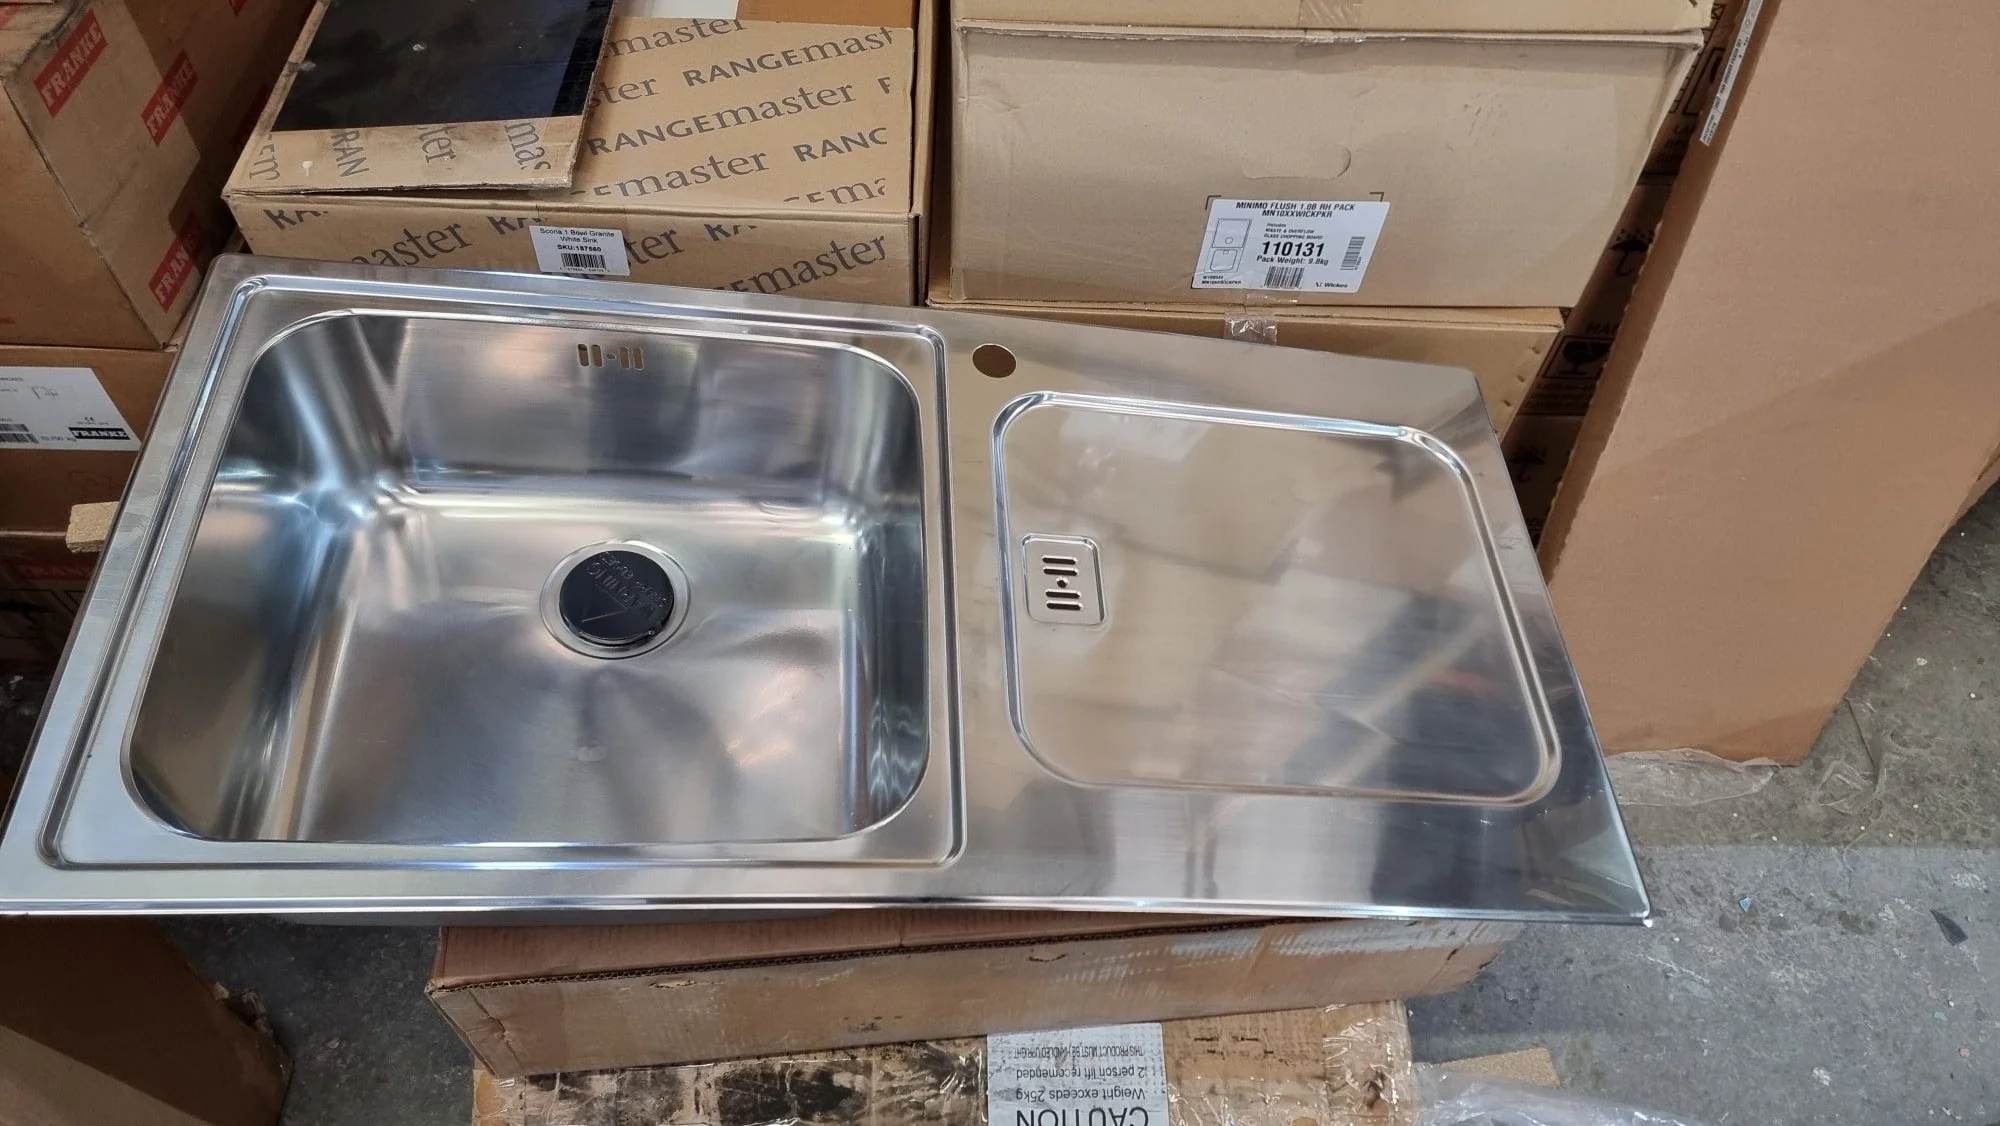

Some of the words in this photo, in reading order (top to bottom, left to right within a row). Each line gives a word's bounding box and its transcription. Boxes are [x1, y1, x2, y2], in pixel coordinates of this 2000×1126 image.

[603, 18, 748, 58] master
[40, 22, 102, 105] FRANKE
[146, 61, 195, 137] FRANKE
[586, 84, 856, 156] RANGEmaster
[1236, 202, 1268, 210] MINIMO
[1270, 203, 1297, 211] FLUSH
[1319, 203, 1331, 211] RH
[1262, 241, 1325, 257] 110131
[1256, 255, 1275, 263] Pack
[1277, 256, 1306, 266] Weight:
[1308, 257, 1329, 266] 9.8kg
[72, 429, 128, 438] FRANKE
[1100, 1045, 1129, 1057] PRODUCT
[1016, 1067, 1081, 1081] recomended
[1084, 1068, 1096, 1080] lift
[1100, 1063, 1135, 1076] person
[1138, 1066, 1145, 1079] 2
[1016, 1086, 1046, 1103] 25kg
[1048, 1088, 1099, 1102] exceeds
[1102, 1086, 1146, 1101] Weight
